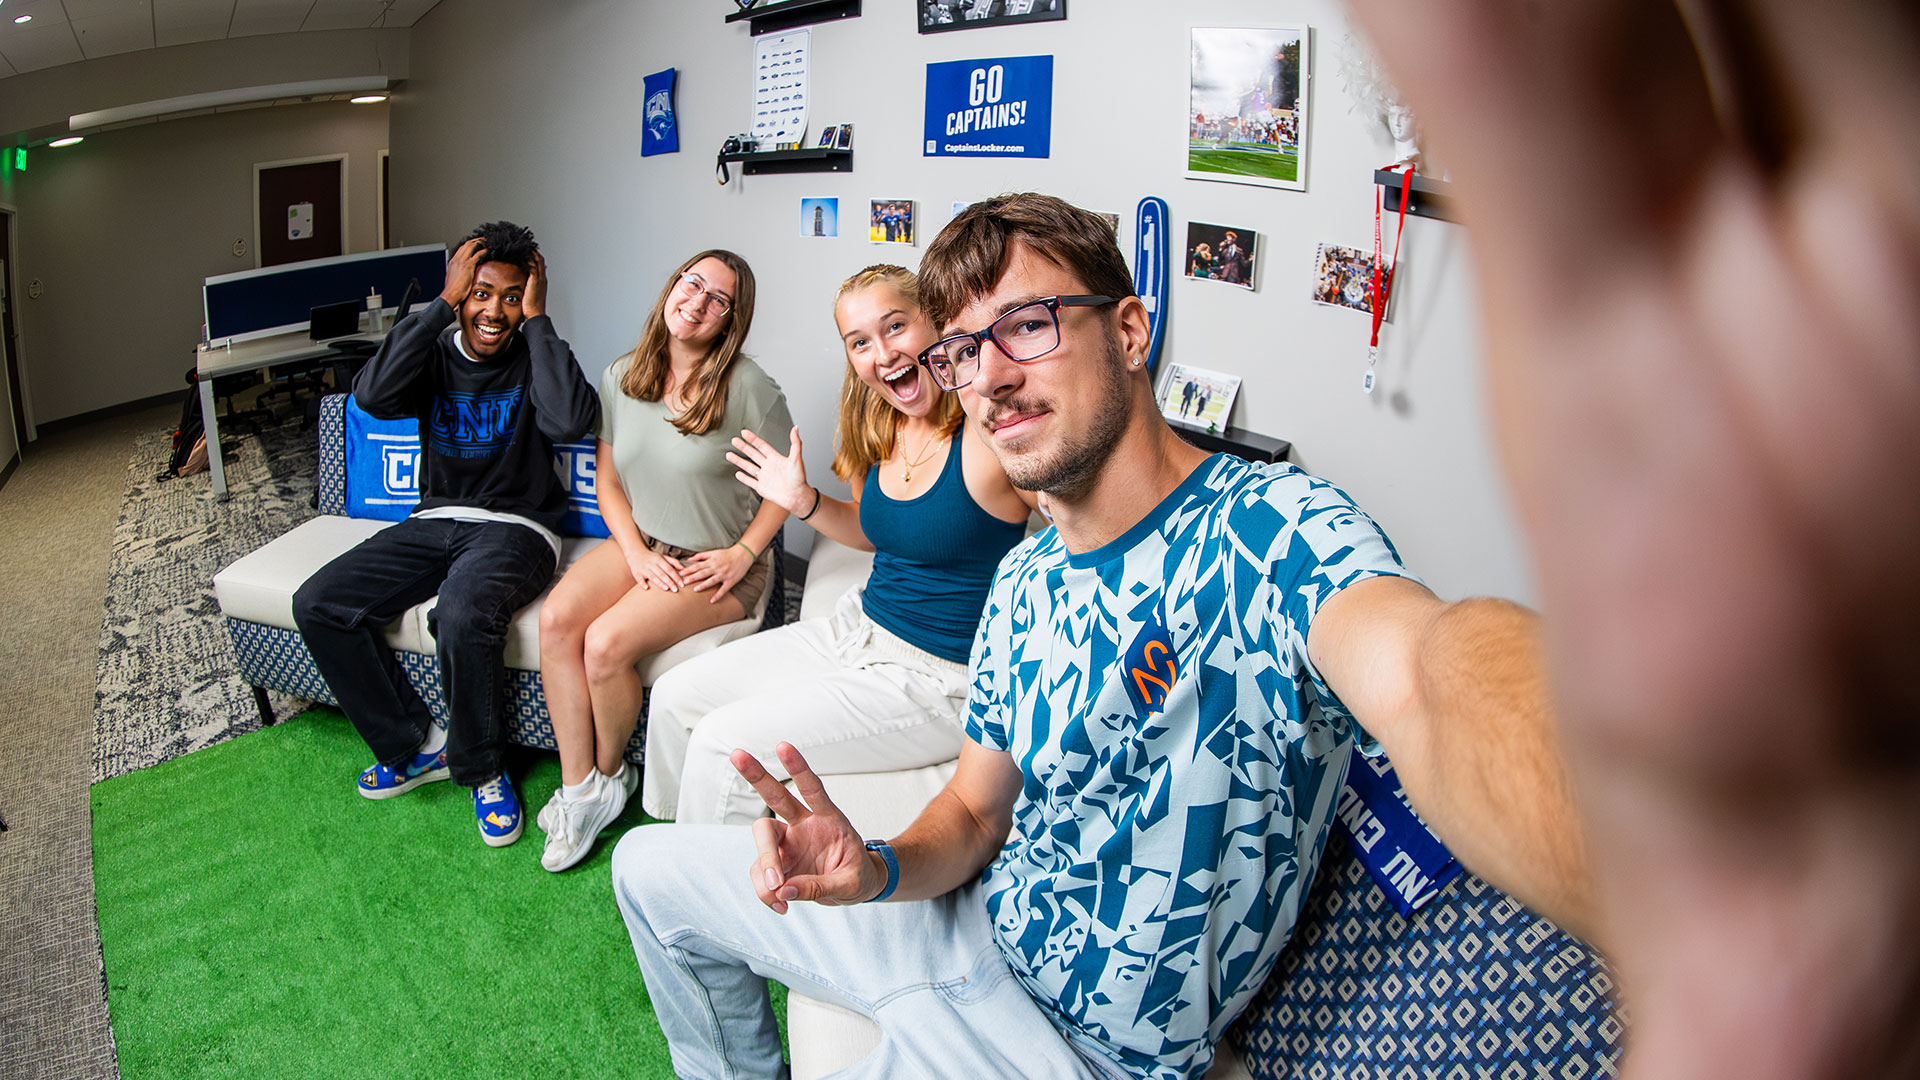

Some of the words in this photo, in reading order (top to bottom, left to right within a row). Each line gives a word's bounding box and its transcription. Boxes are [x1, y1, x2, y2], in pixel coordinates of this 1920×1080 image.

[969, 65, 1003, 106] GO
[946, 100, 1027, 136] CAPTAINS!
[944, 143, 1024, 153] CaptainsLocker.com
[430, 396, 523, 443] CNU
